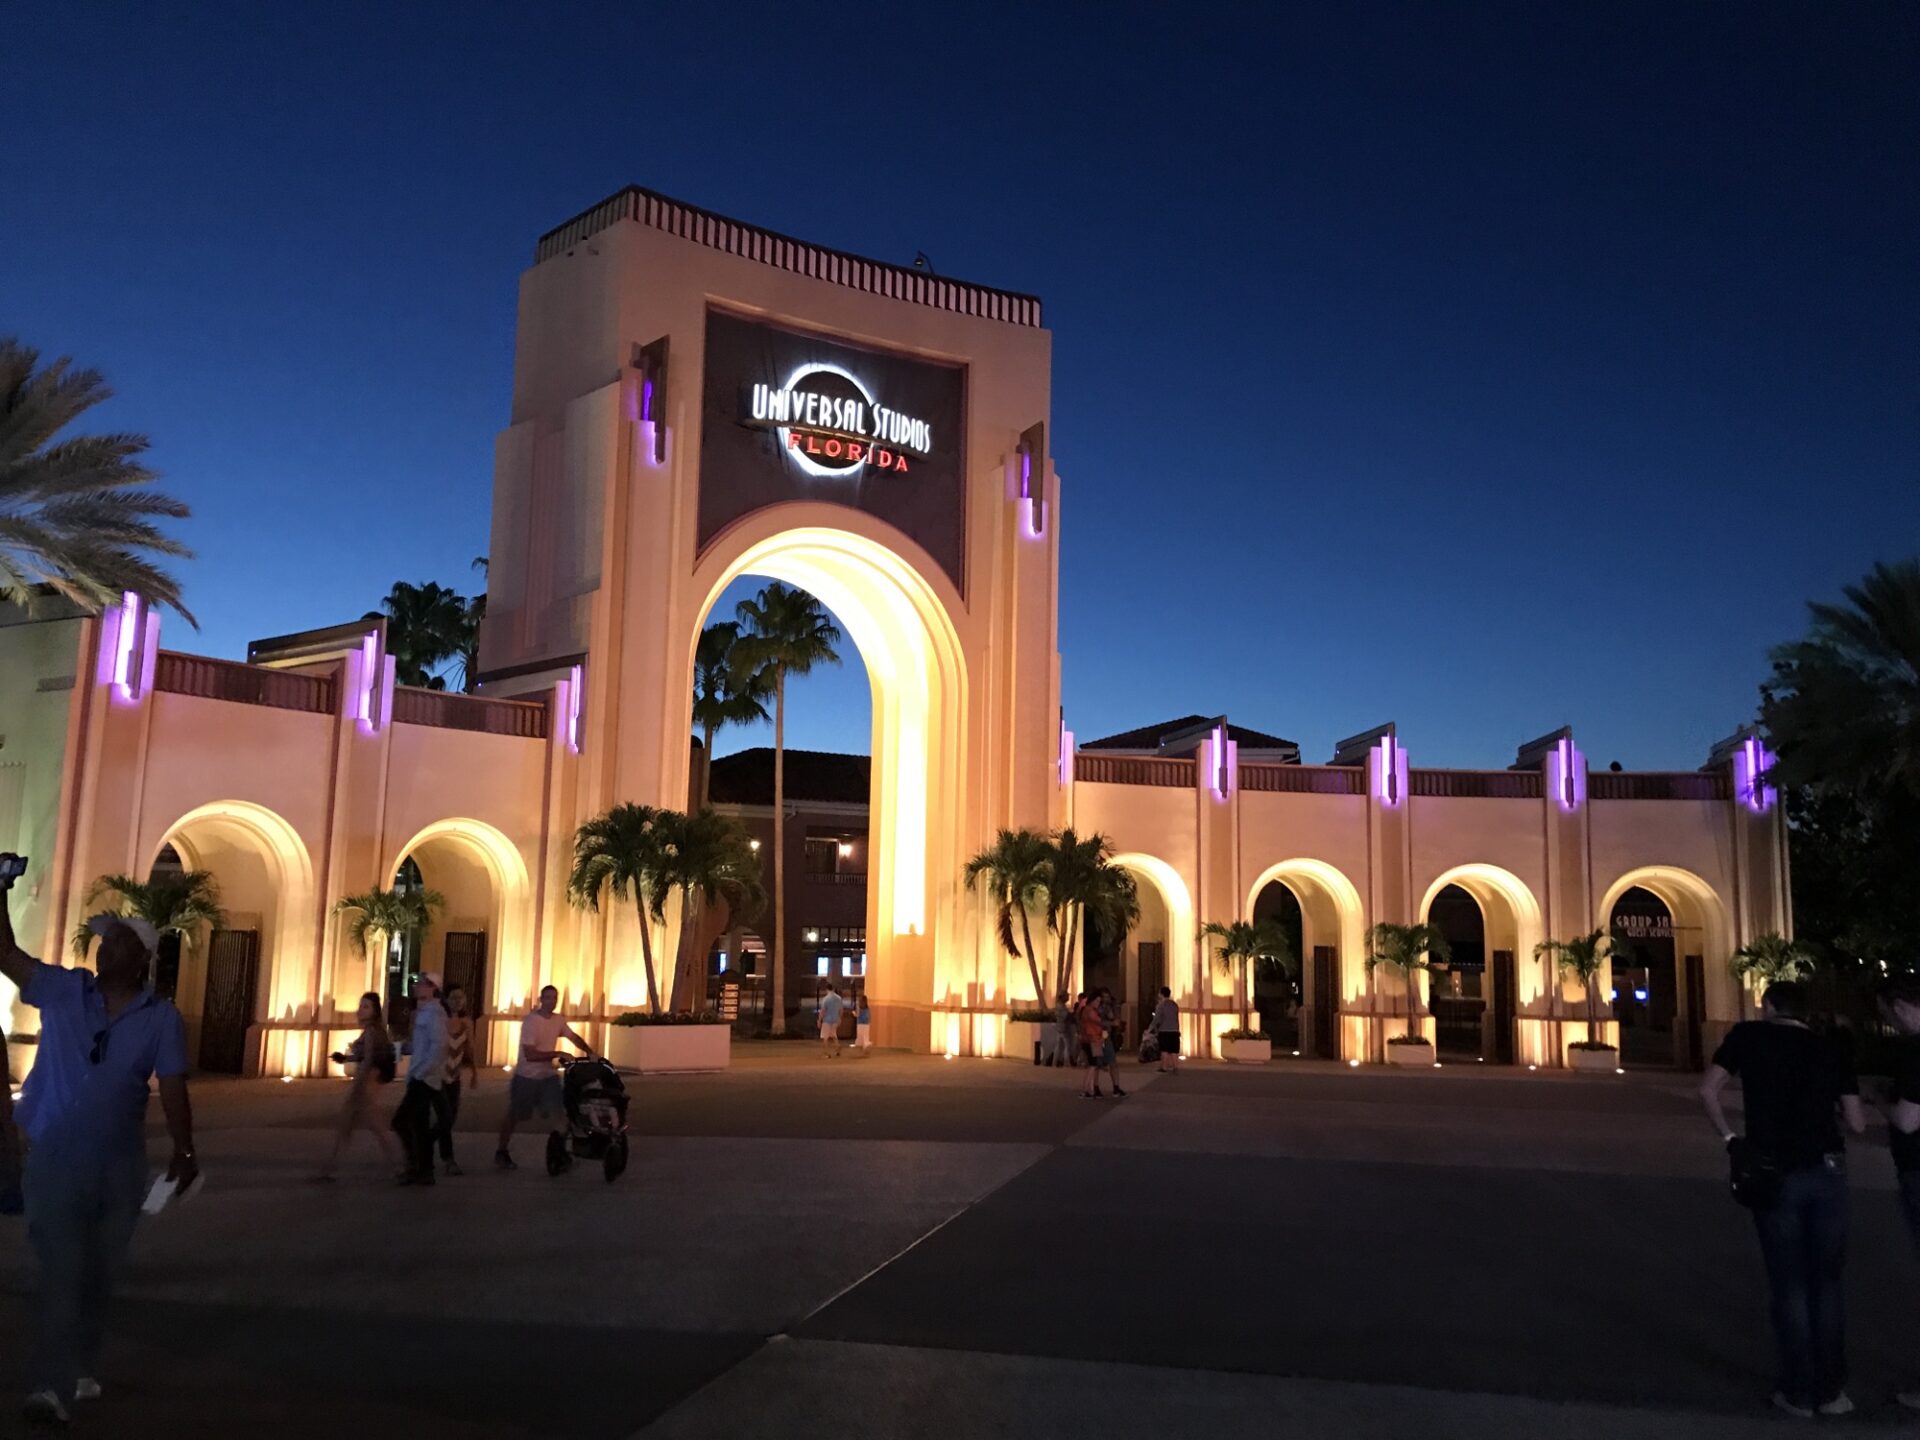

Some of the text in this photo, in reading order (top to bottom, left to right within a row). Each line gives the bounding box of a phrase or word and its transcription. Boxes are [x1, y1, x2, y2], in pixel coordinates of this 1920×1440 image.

[753, 384, 931, 453] UNIVERSAL STUDIOS
[788, 434, 907, 472] FLORIDA
[1616, 915, 1652, 928] GROUP
[1627, 928, 1646, 937] GUEST
